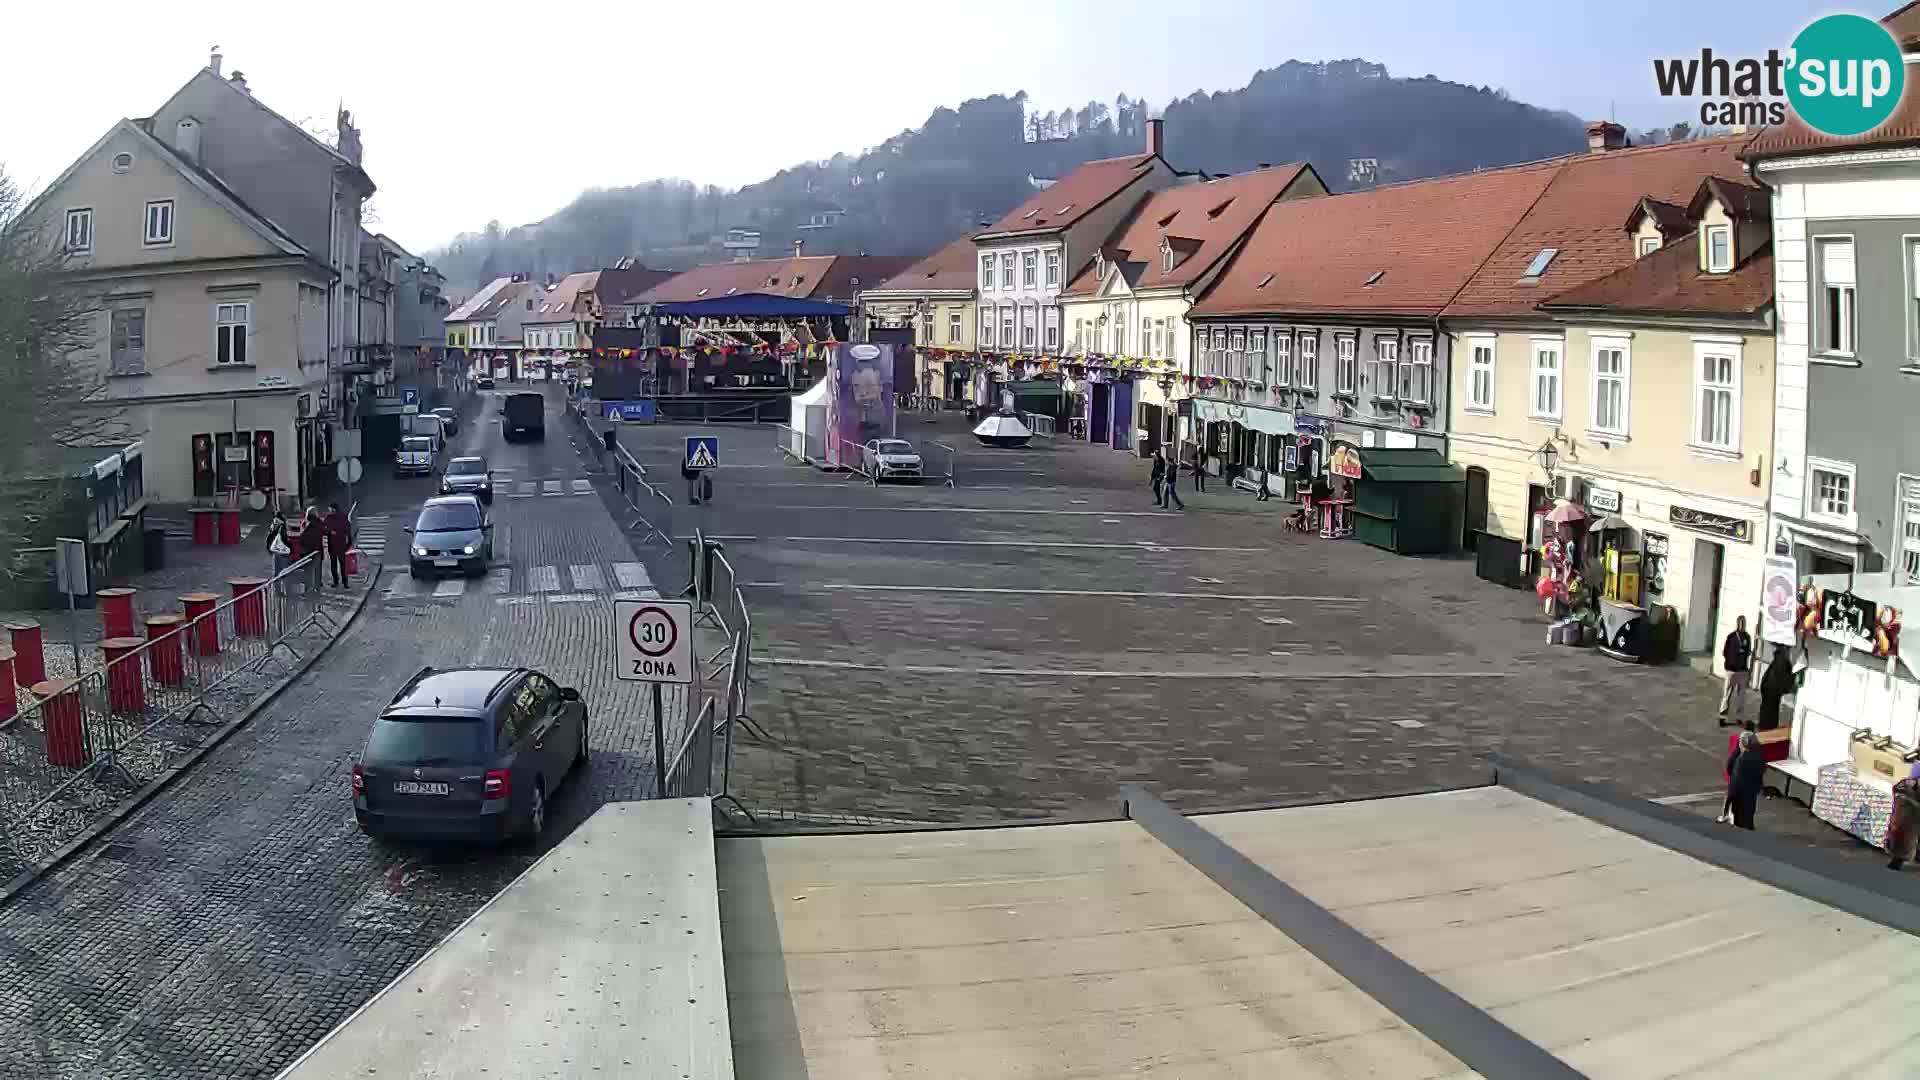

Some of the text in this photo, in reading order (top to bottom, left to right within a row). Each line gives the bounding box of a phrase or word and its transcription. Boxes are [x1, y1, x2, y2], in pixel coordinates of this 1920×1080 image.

[406, 391, 414, 403] P
[642, 622, 666, 643] 30
[632, 659, 677, 676] ZONA
